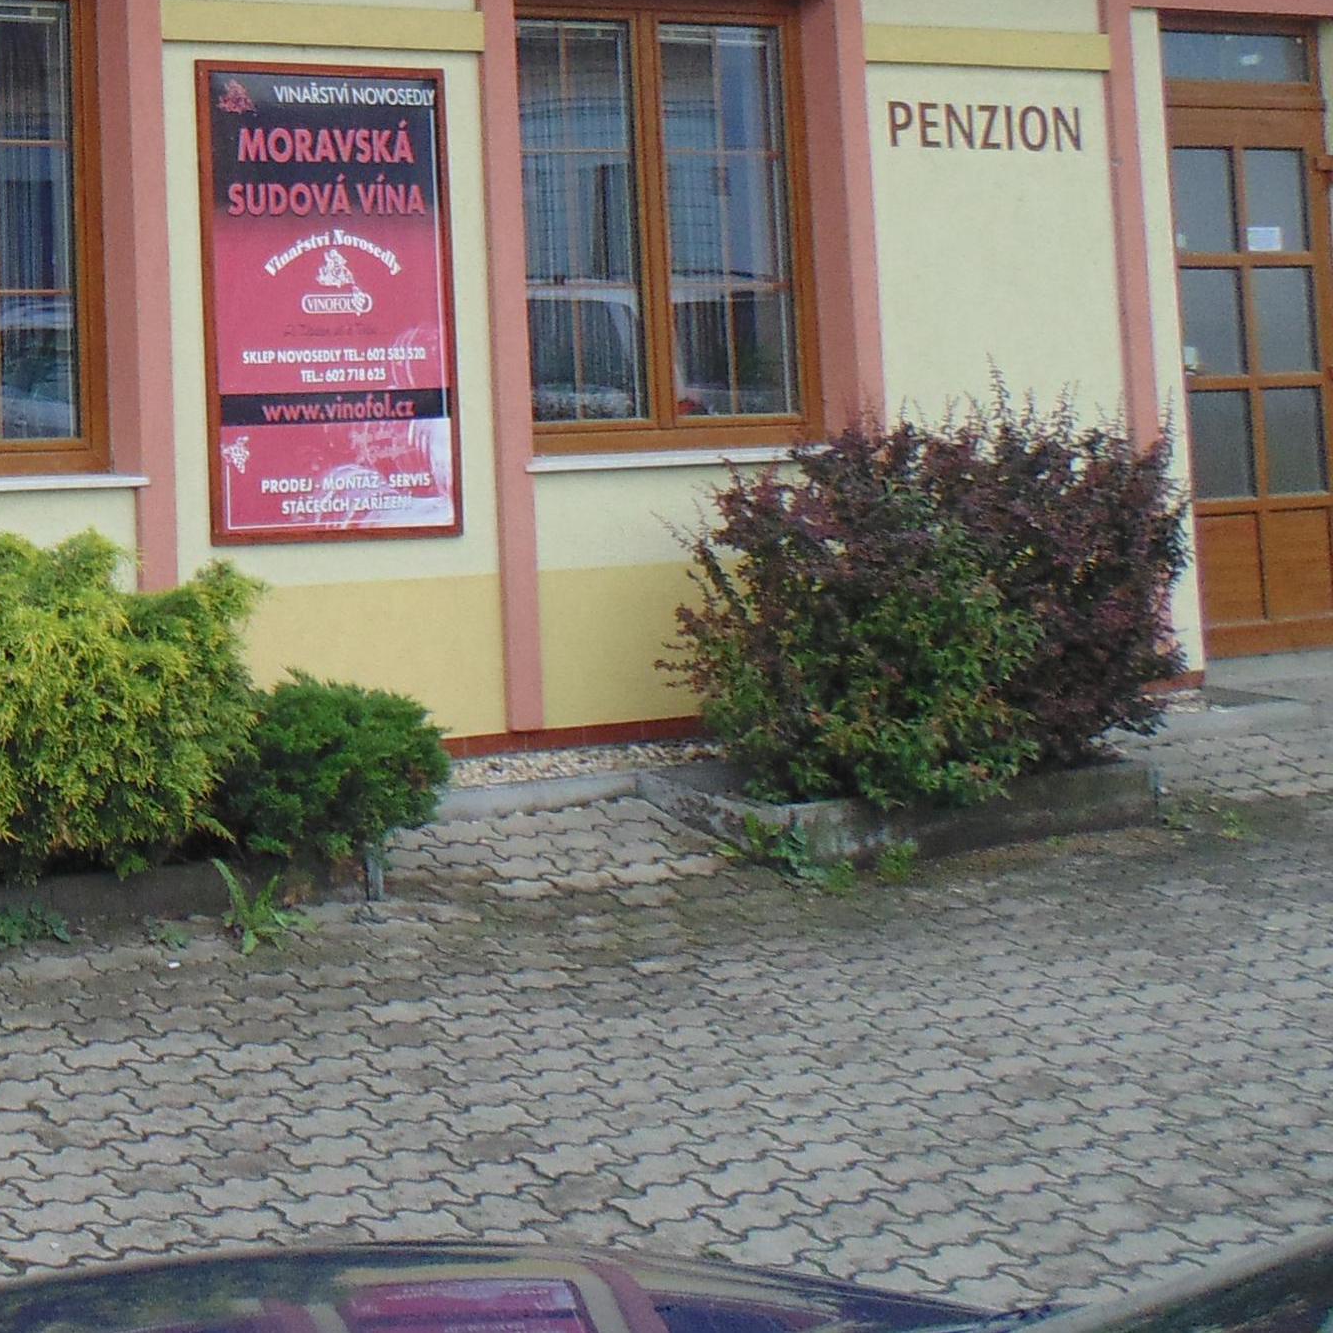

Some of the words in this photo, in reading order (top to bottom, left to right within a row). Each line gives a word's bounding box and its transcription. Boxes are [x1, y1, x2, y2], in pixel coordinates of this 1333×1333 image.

[273, 82, 350, 105] VINAŘSTVÍ
[351, 87, 435, 107] NOVOSEDLY
[887, 100, 1082, 152] PENZION
[237, 119, 415, 165] MORAVSKÁ
[227, 173, 352, 217] SUDOVÁ
[355, 174, 427, 217] VÍNA
[264, 230, 331, 277] Vinařství
[332, 229, 402, 276] Novosedly
[242, 349, 275, 365] SKLEP
[277, 348, 342, 364] NOVOSEDLY
[366, 347, 387, 362] 602
[325, 369, 346, 383] 602
[262, 394, 416, 422] www.vinofol.cz
[261, 477, 313, 495] PRODEJ
[388, 472, 431, 488] SERVIS
